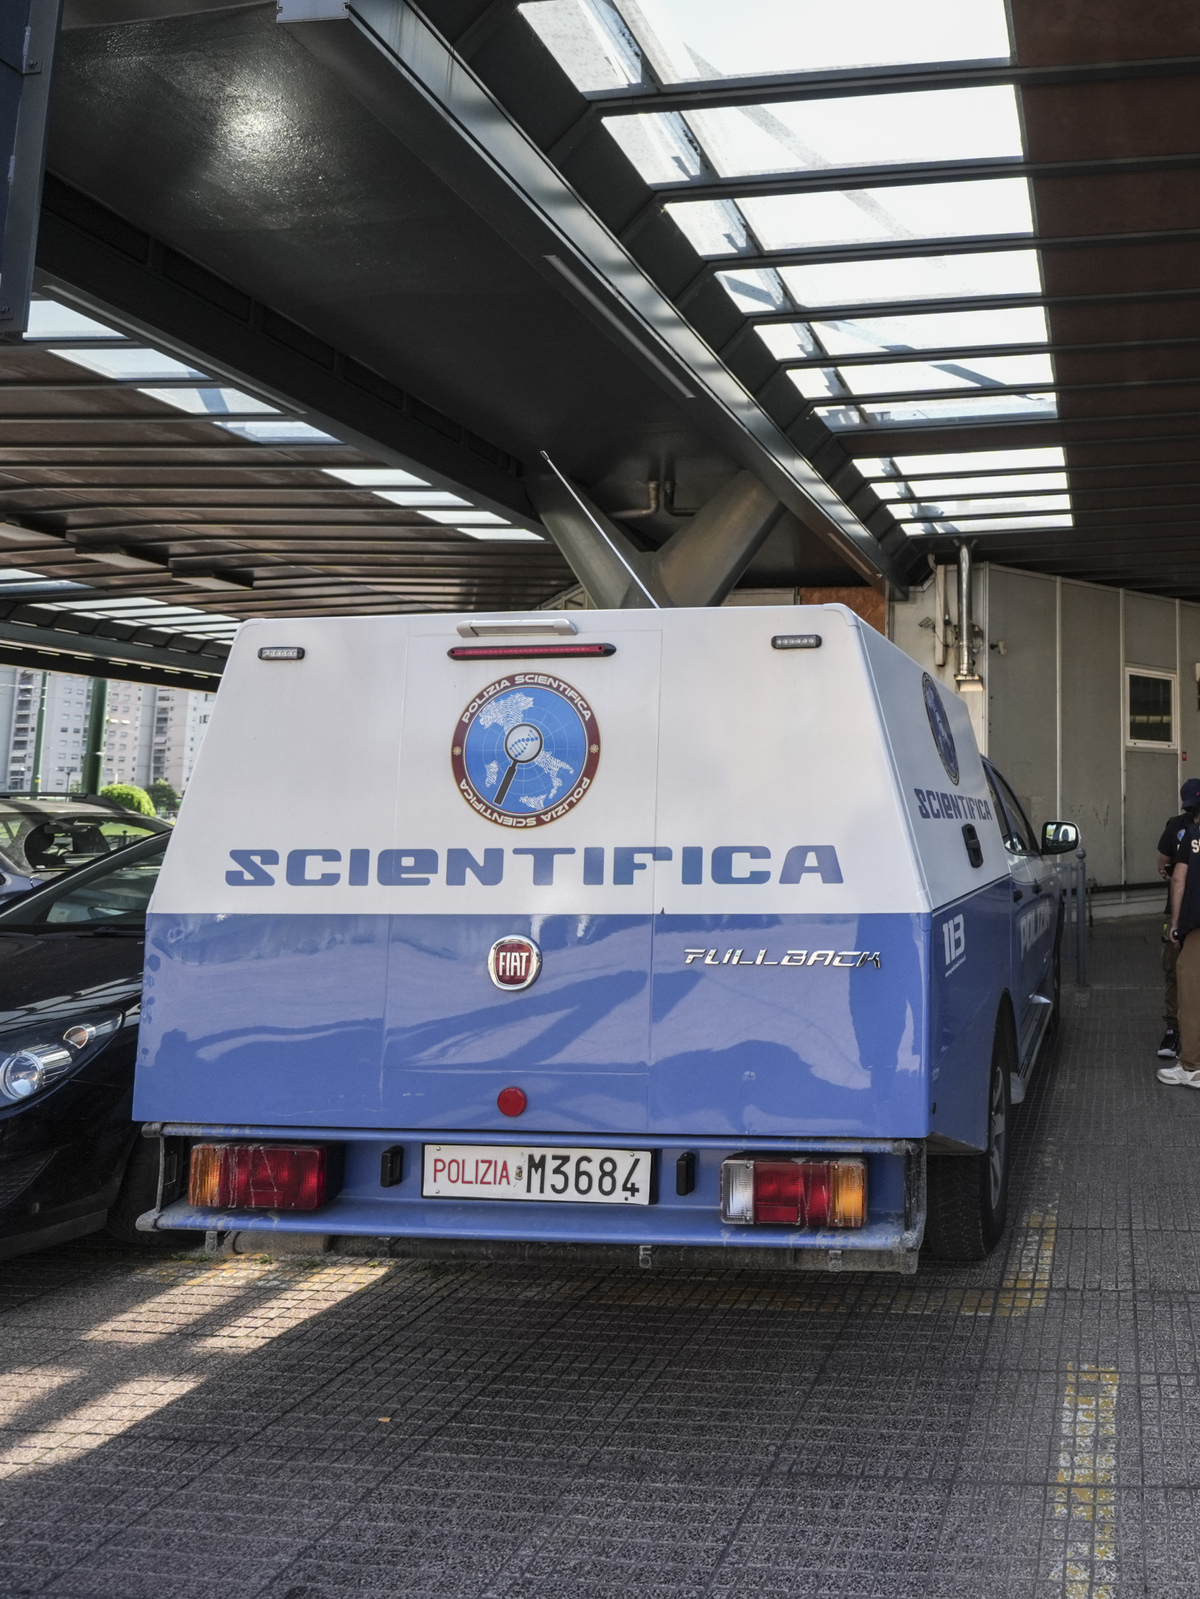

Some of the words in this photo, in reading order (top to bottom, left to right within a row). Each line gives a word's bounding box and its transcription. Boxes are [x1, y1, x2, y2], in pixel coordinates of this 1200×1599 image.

[461, 679, 511, 723] POLIZIA
[514, 674, 592, 721] SCIENTIFICA
[459, 778, 537, 827] SCIENTIFICA
[540, 777, 591, 822] POLIZIA
[684, 948, 881, 969] FULLBACK
[942, 913, 966, 966] 113
[498, 951, 530, 977] FIAT
[433, 1158, 511, 1186] POLIZIA
[526, 1153, 642, 1198] M3684
